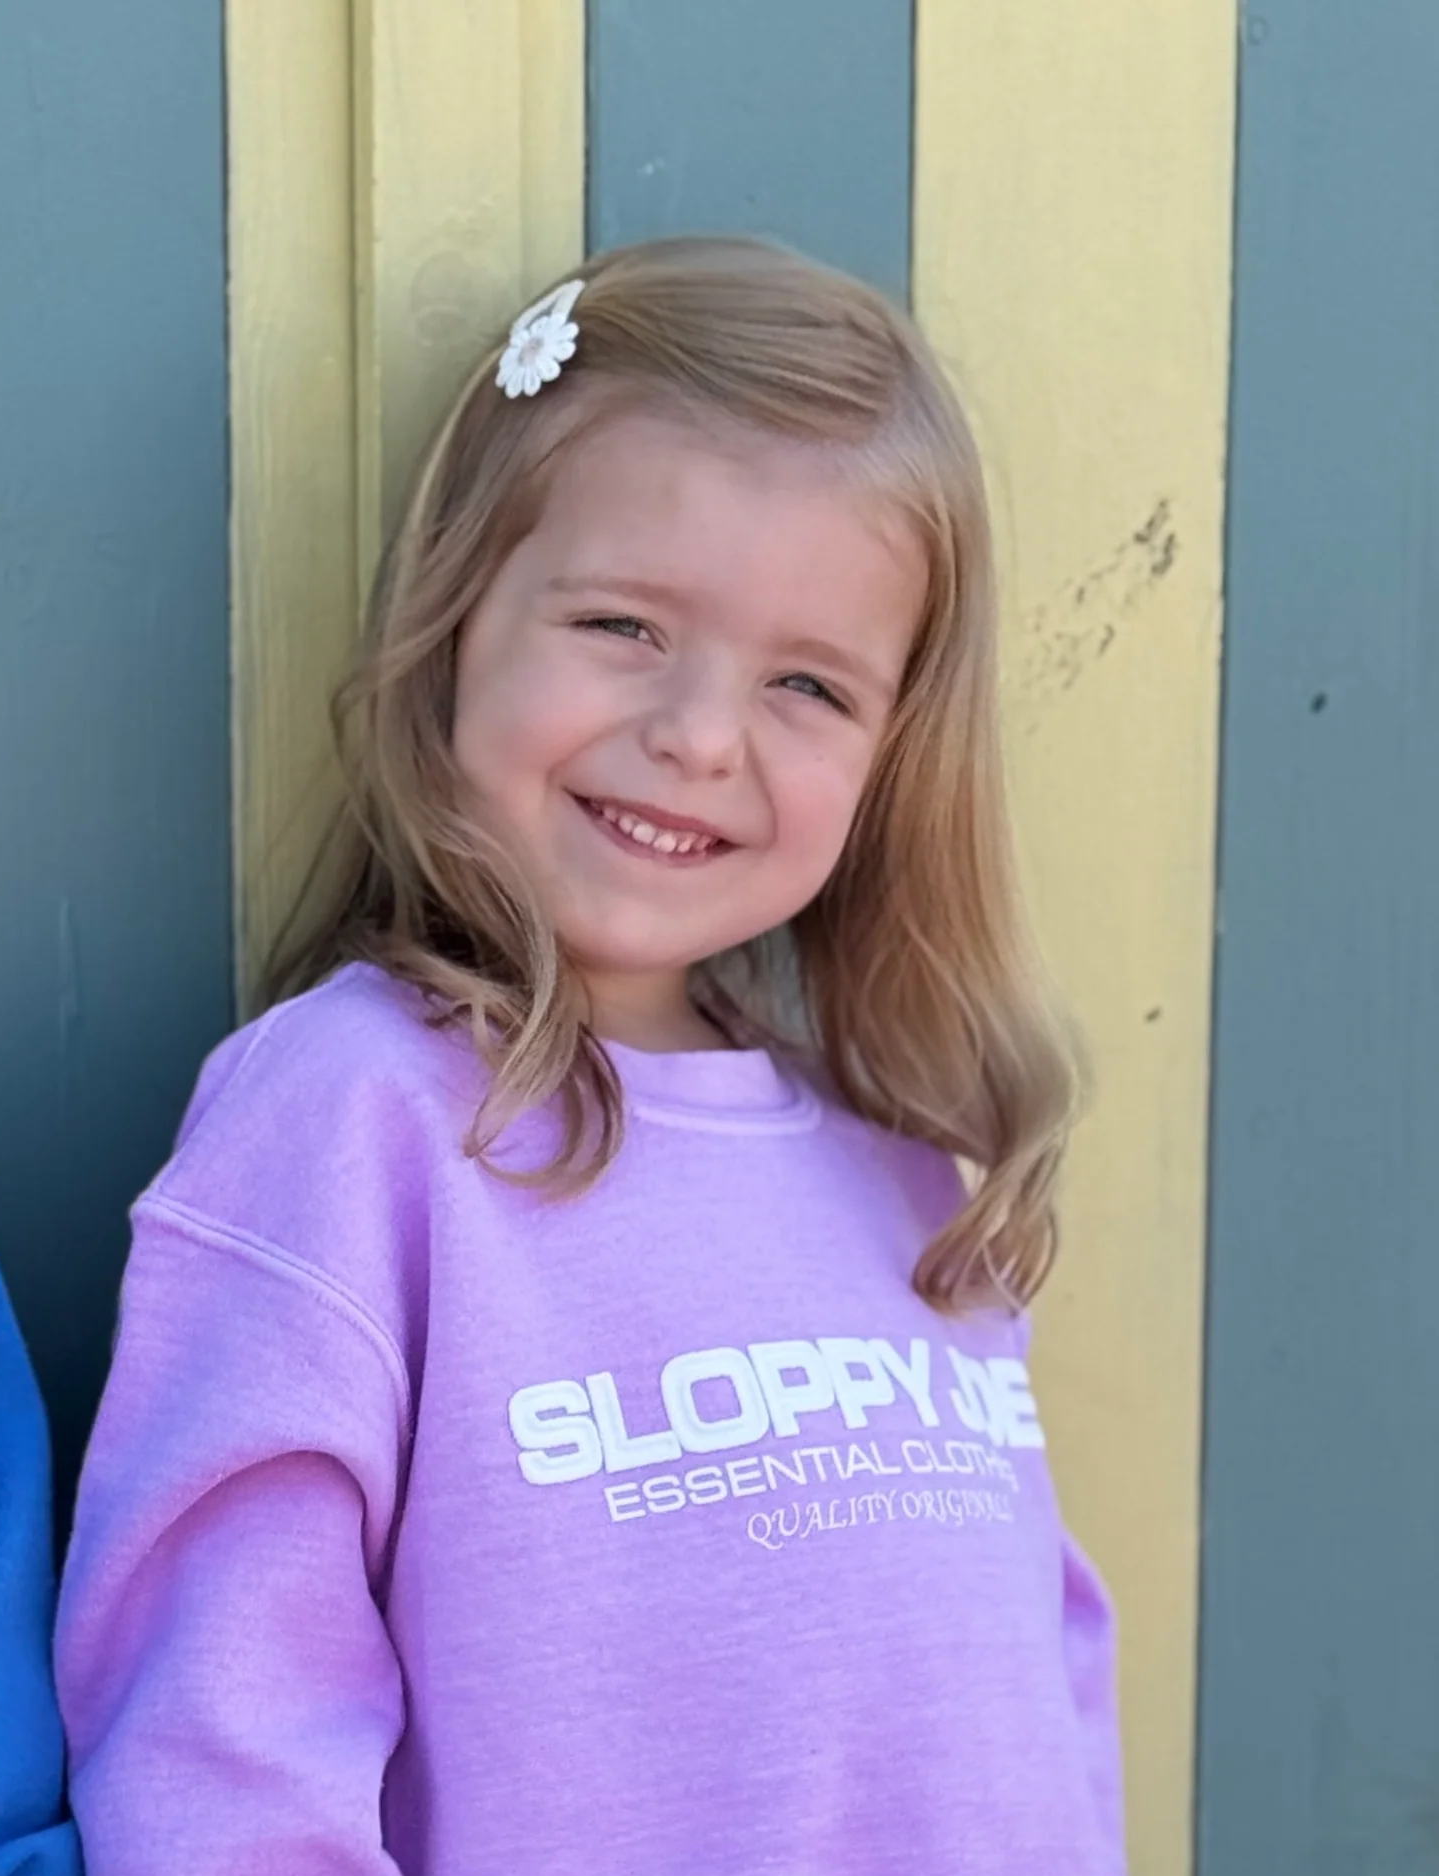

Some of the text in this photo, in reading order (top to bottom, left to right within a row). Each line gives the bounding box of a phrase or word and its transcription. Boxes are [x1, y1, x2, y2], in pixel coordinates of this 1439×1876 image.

[509, 1338, 939, 1485] SLOPPY
[604, 1442, 902, 1522] ESSENTIAL
[747, 1489, 898, 1550] QUALITY
